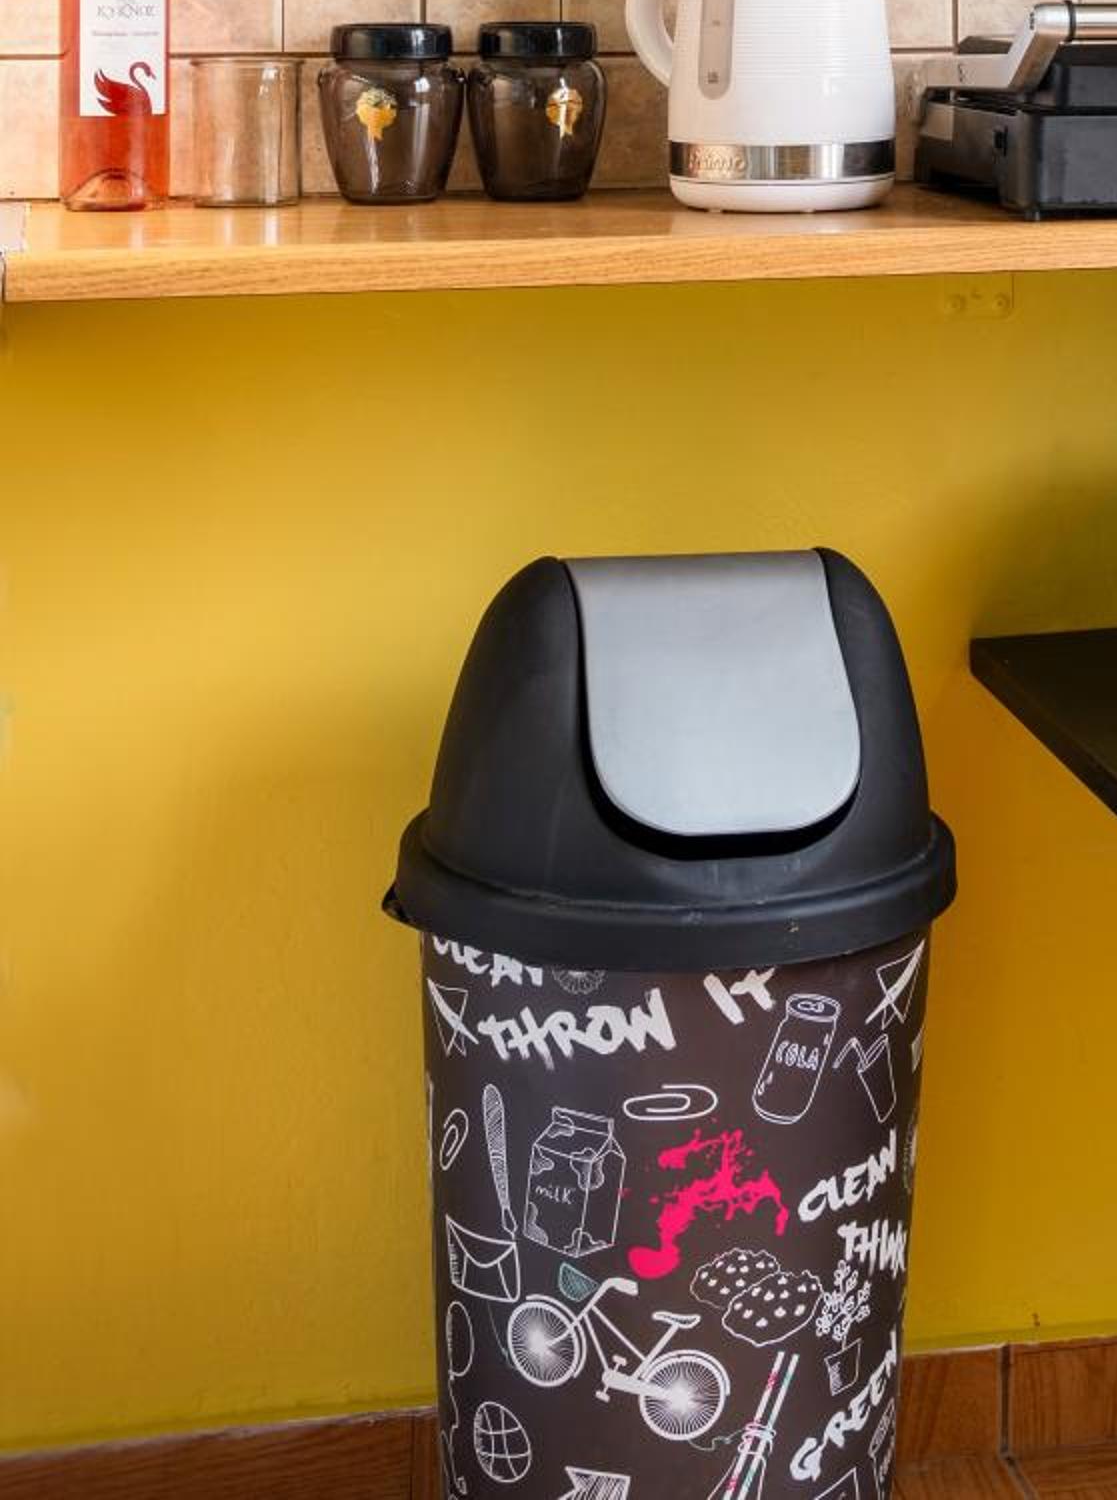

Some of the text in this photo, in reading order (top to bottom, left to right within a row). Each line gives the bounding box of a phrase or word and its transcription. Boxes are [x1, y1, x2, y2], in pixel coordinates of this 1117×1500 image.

[477, 987, 676, 1071] THROW
[776, 1040, 819, 1071] COLA
[797, 1127, 896, 1222] CLEAN
